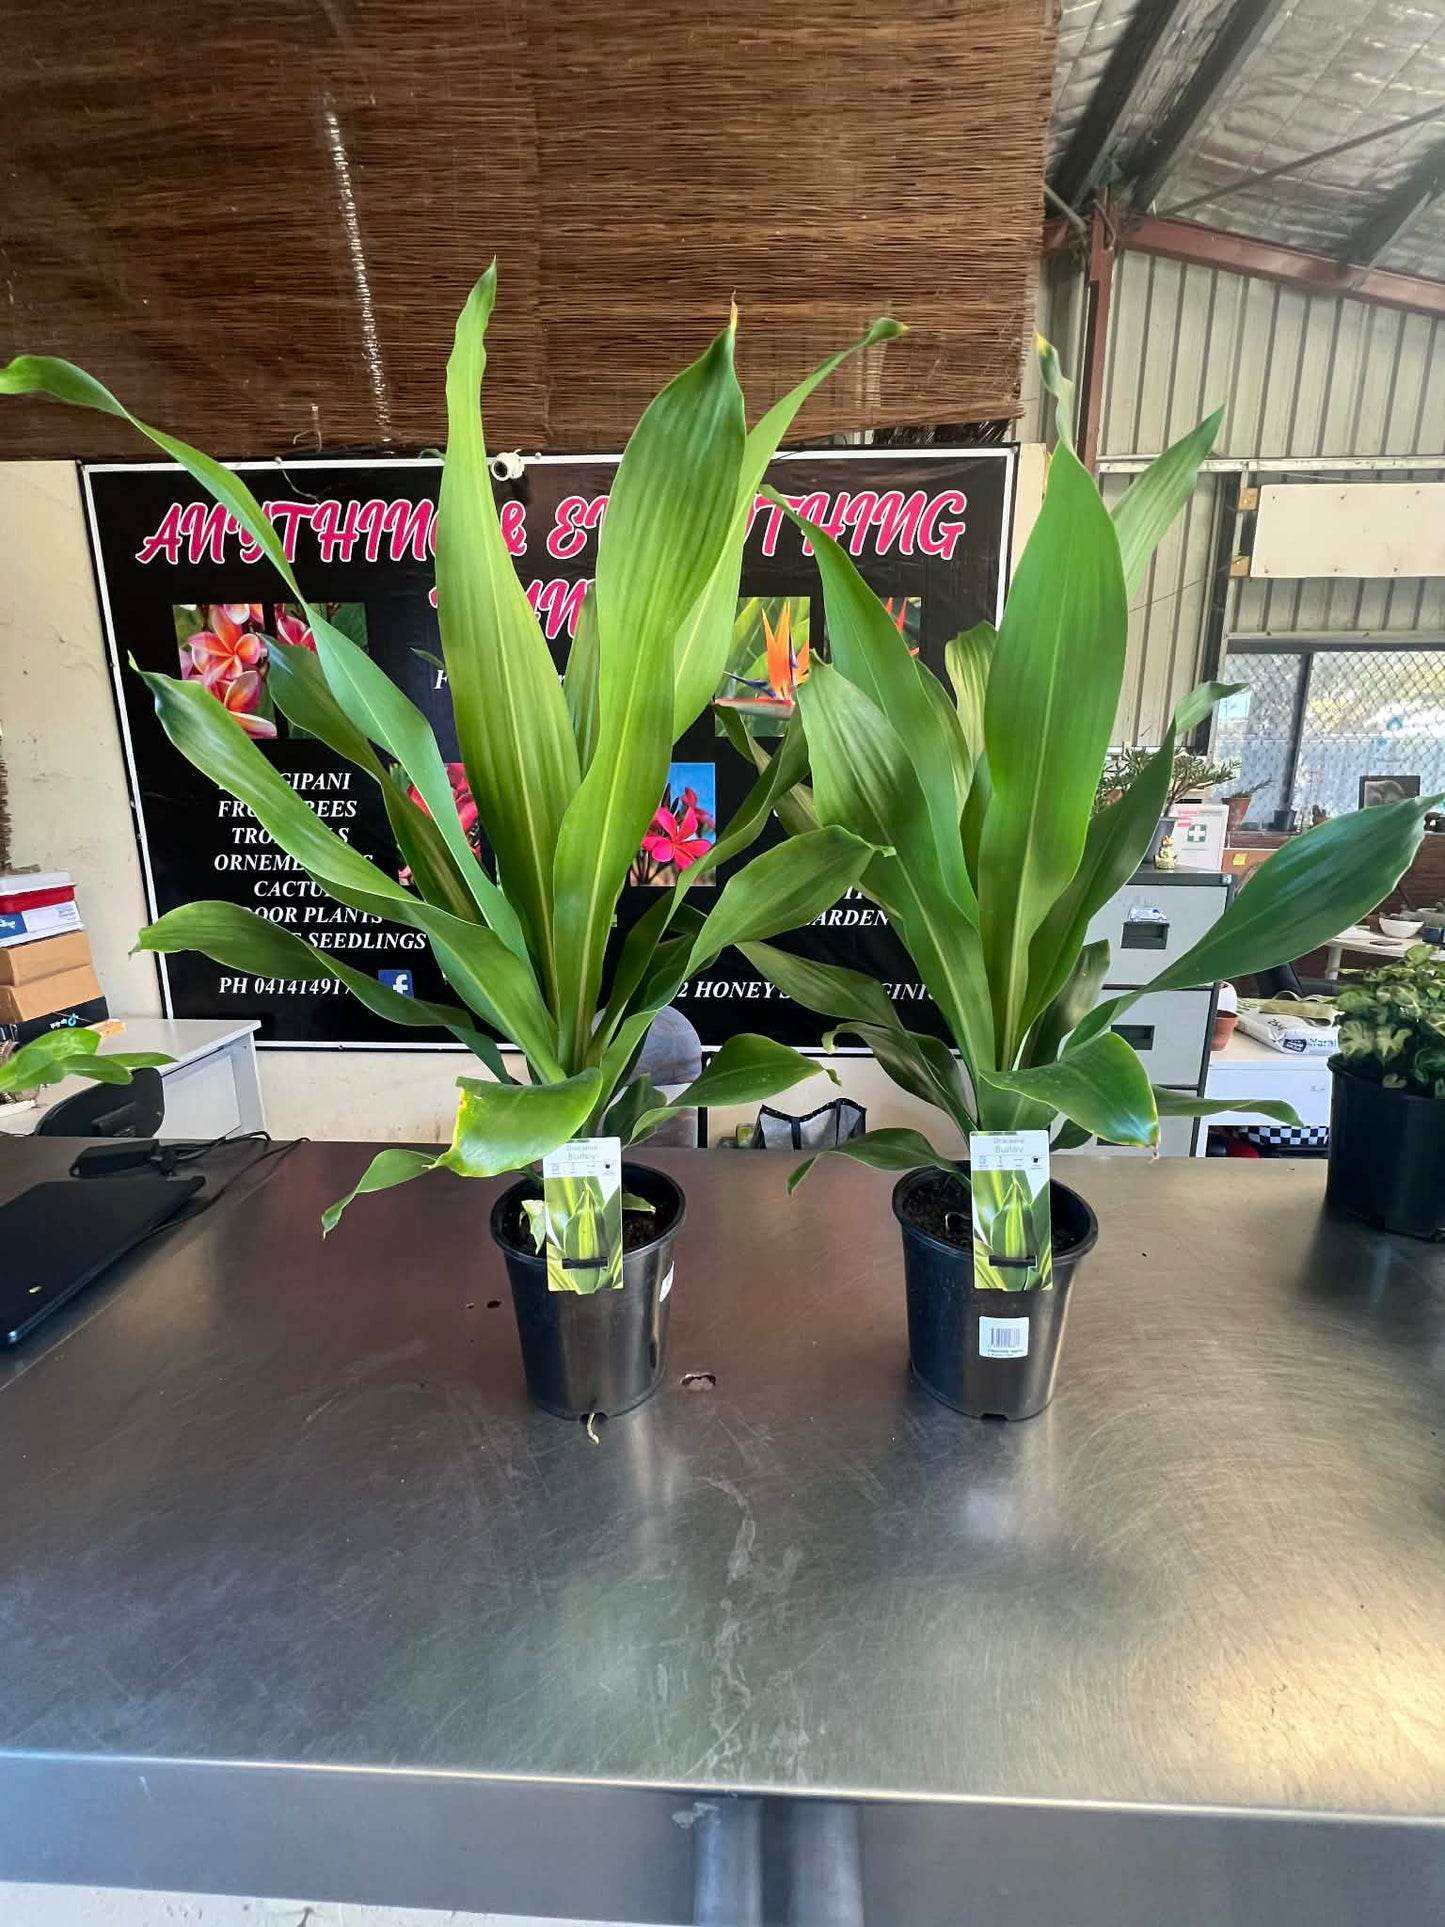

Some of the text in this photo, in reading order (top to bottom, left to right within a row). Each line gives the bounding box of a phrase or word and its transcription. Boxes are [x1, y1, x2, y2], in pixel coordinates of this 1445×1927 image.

[253, 881, 330, 897] CACTU
[805, 909, 889, 926] ARDEN
[308, 933, 427, 949] SEEDLINGS
[218, 977, 350, 995] PH 04141491
